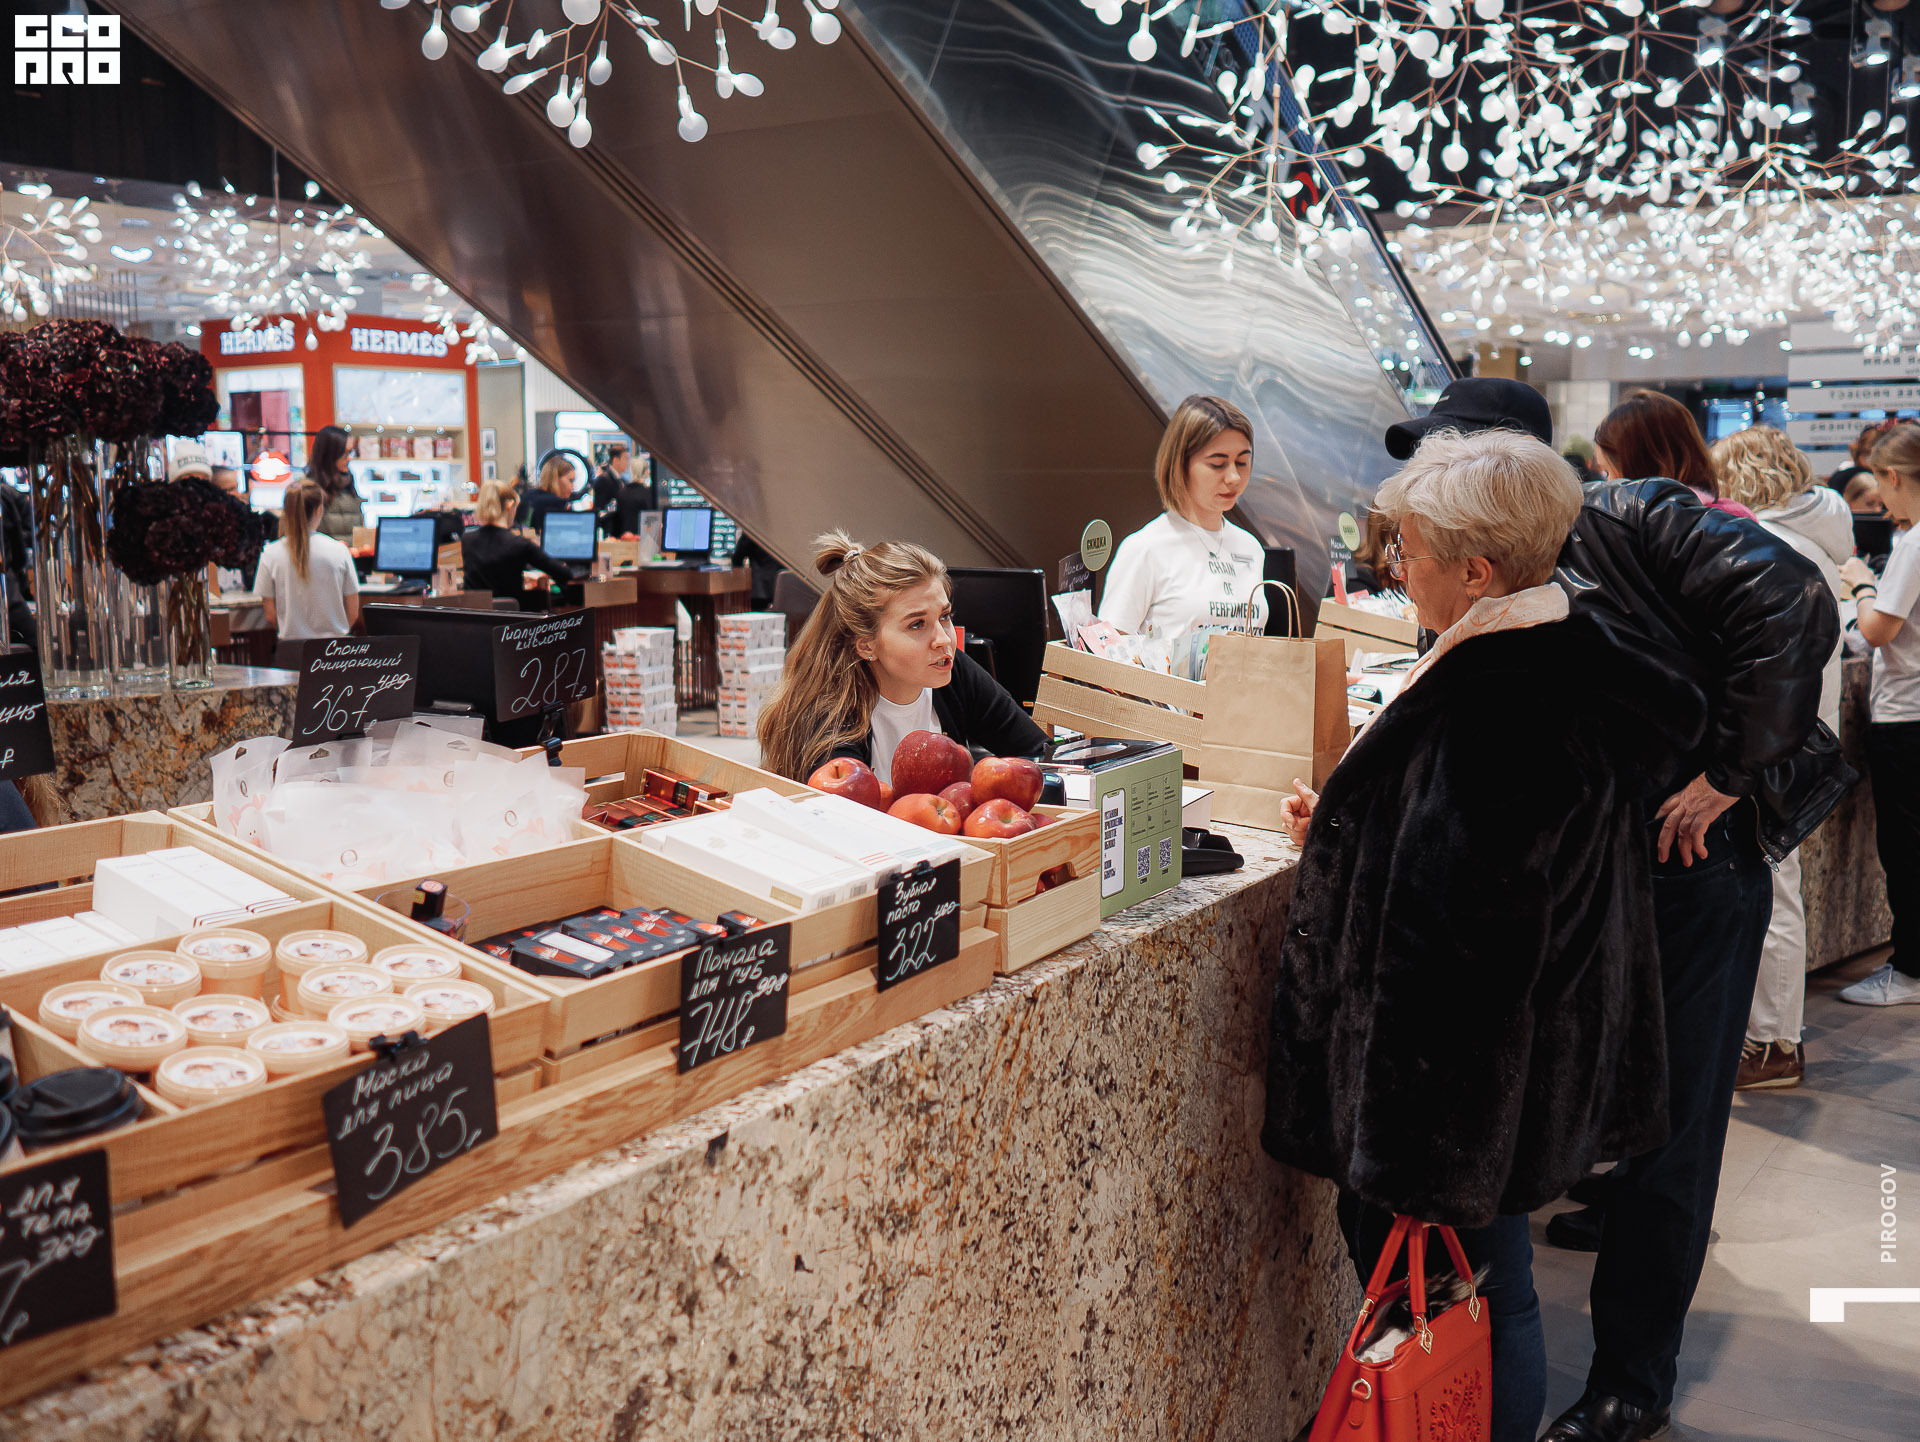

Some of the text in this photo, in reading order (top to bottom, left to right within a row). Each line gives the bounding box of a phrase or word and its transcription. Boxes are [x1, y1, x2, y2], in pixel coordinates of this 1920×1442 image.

[1208, 561, 1236, 576] CHAIN
[1223, 581, 1234, 595] OF
[325, 639, 370, 656] Спонж
[694, 938, 778, 979] Помада
[688, 977, 720, 1001] для
